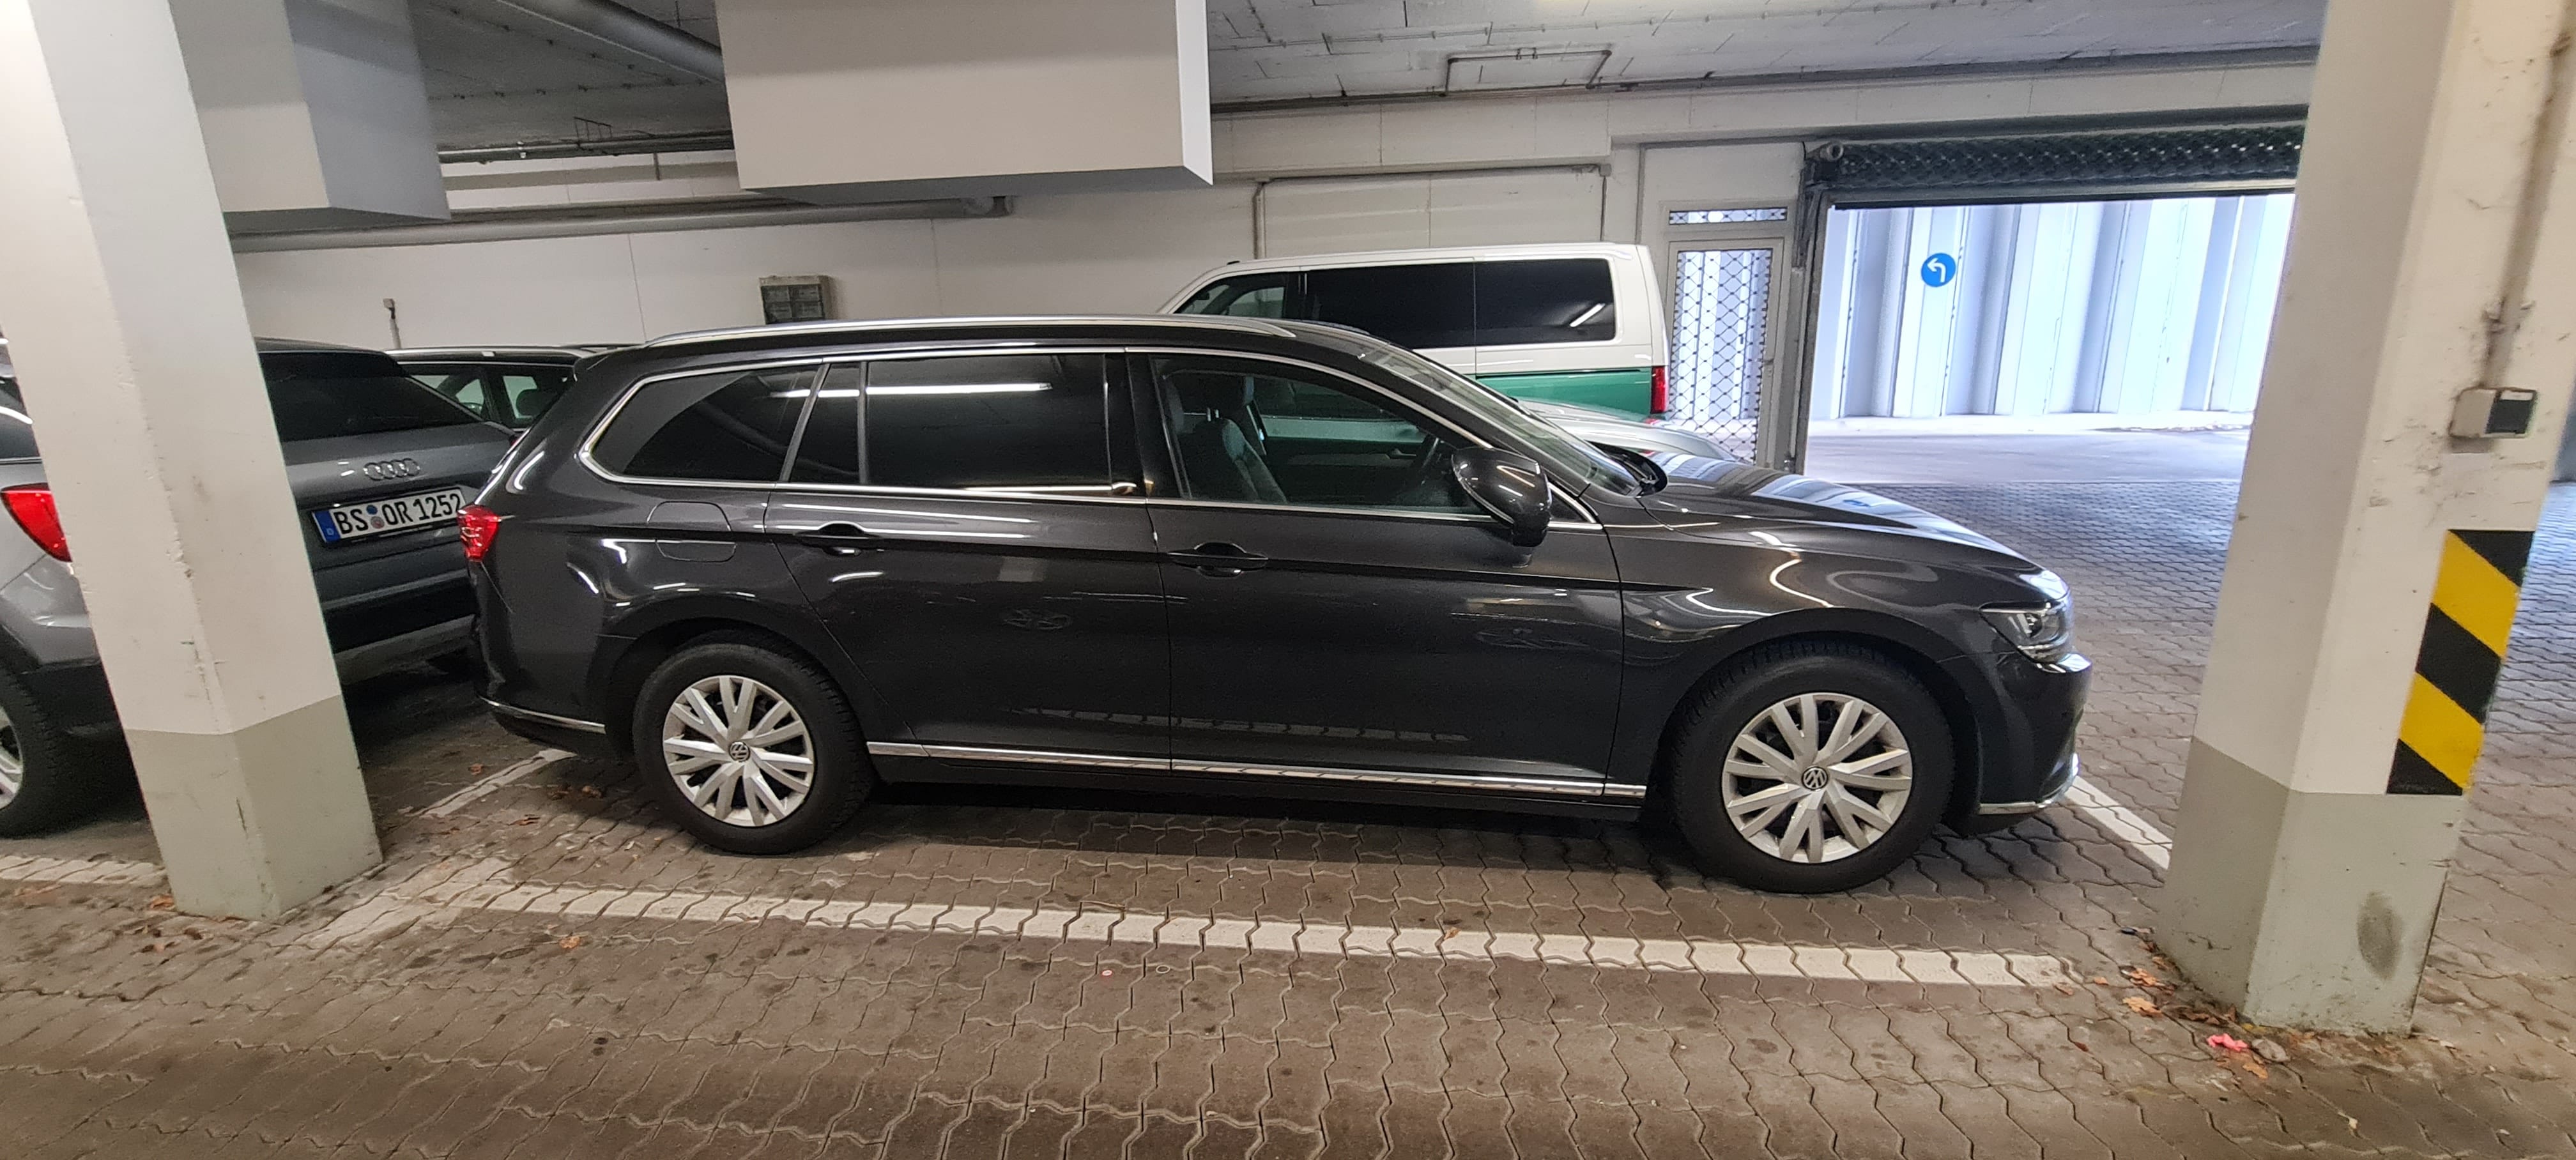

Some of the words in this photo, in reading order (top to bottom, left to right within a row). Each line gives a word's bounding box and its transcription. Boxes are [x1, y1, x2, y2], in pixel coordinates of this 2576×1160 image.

[333, 509, 369, 535] BS
[381, 501, 413, 526] OR
[413, 493, 461, 521] 1252
